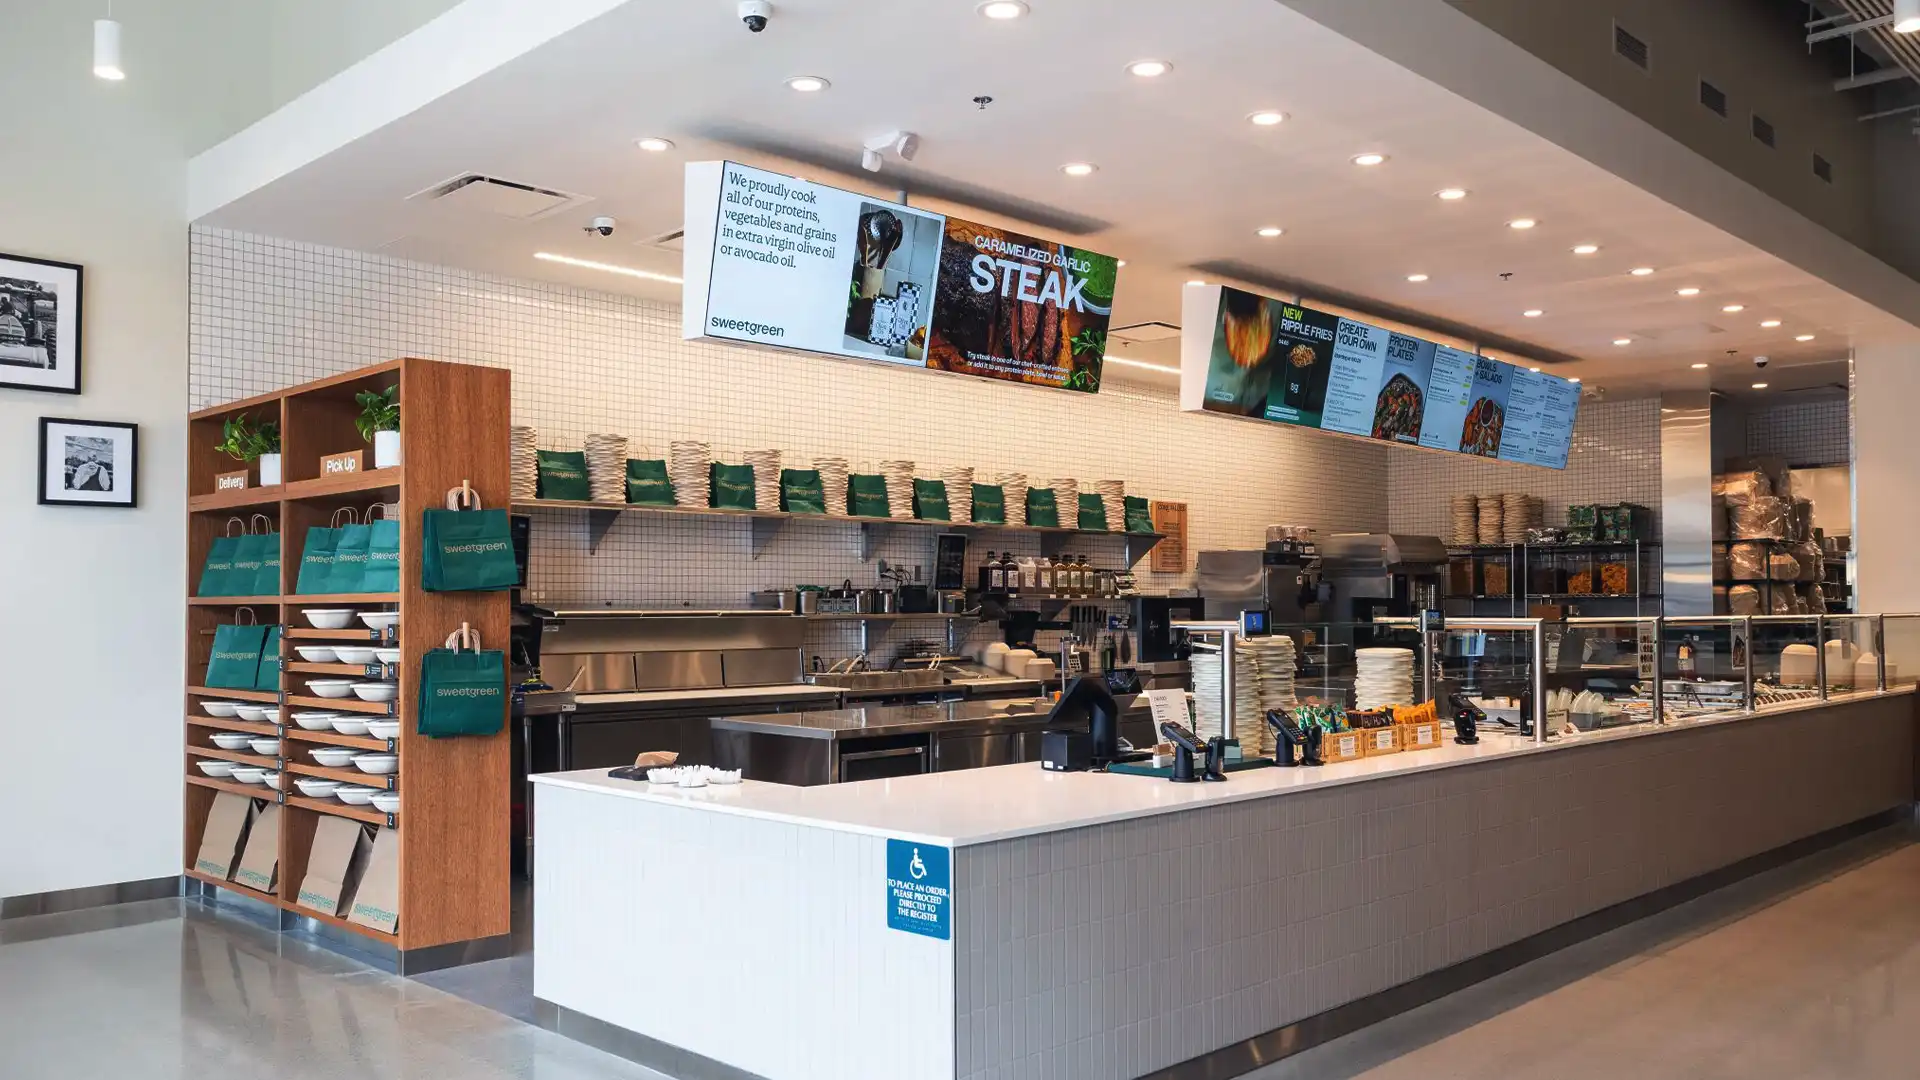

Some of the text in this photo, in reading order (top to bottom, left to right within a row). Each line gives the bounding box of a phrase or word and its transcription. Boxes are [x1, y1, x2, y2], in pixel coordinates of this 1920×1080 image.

[729, 171, 817, 204] We proudly cook
[726, 190, 820, 223] all of our proteins,
[724, 207, 837, 243] vegetables and grains
[722, 225, 836, 259] in extra virgin olive oil
[720, 243, 797, 268] or avocado oil.
[974, 235, 1091, 273] CARAMELIZED GARLIC
[969, 254, 1089, 313] STEAK
[1282, 306, 1303, 321] NEW
[711, 316, 784, 337] sweetgreen
[1280, 319, 1310, 337] RIPPLE
[1311, 324, 1334, 341] FRIES
[1339, 321, 1369, 339] CREATE
[1337, 333, 1358, 348] YOUR
[1359, 338, 1377, 352] OWN
[1388, 335, 1420, 352] PROTEIN
[976, 353, 991, 361] steak
[1387, 346, 1415, 362] PLATES
[1004, 367, 1022, 375] protein
[1476, 358, 1497, 372] BOWLS
[1479, 370, 1503, 384] SALADS
[326, 456, 356, 474] Pick Up
[219, 476, 244, 490] Delivery
[444, 542, 507, 554] sweetgreen
[279, 626, 284, 636] A
[215, 650, 257, 662] sweetgreen
[279, 659, 283, 669] E
[388, 665, 394, 675] H
[436, 687, 500, 698] sweetgreen
[388, 703, 393, 713] L
[388, 740, 394, 749] P
[388, 778, 393, 788] T
[278, 792, 283, 803] U
[388, 815, 393, 826] Z
[238, 868, 271, 885] sweetgreen
[888, 878, 896, 887] TO
[896, 880, 915, 891] PLACE
[915, 884, 925, 892] AN
[299, 890, 337, 910] sweetgreen
[893, 888, 942, 905] PLEASE PROCEED
[354, 903, 397, 923] sweetgreen
[899, 899, 936, 913] DIRECTLY TO
[898, 907, 938, 922] THE REGISTER
